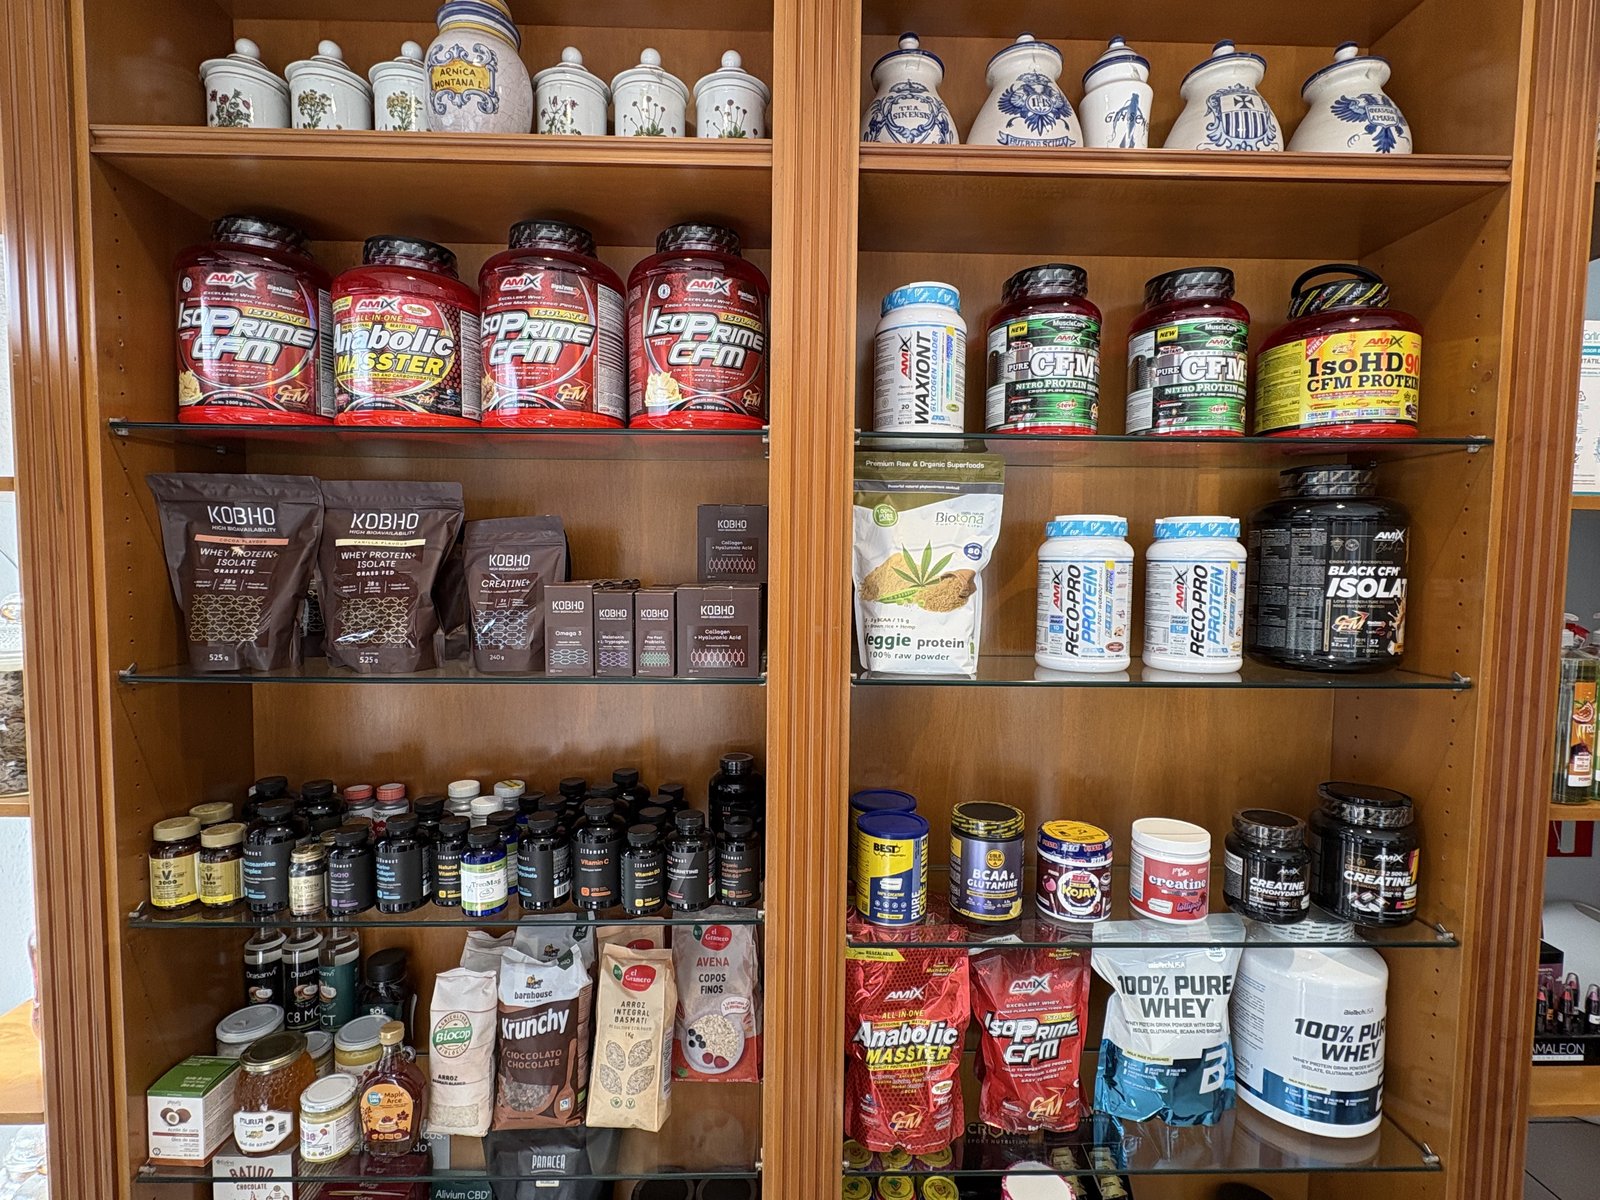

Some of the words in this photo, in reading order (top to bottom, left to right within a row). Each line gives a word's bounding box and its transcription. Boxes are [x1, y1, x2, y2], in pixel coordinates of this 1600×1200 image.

[439, 68, 477, 77] ARNICA
[434, 77, 474, 90] MONTANA
[209, 272, 255, 289] AMIX
[502, 273, 543, 291] AMIX
[689, 277, 732, 294] AMIX
[357, 298, 399, 312] AMIX
[248, 308, 307, 325] ISOLATE
[535, 309, 588, 321] ISOLATE
[1010, 325, 1026, 333] NEW
[1159, 330, 1175, 338] NEW
[334, 324, 453, 355] Anabolic
[192, 336, 281, 364] CFM
[490, 341, 563, 364] CFM
[668, 342, 746, 368] CFM
[337, 353, 444, 375] MASSTER
[1009, 362, 1029, 372] PURE
[1030, 352, 1095, 378] CFM
[1156, 367, 1180, 376] PURE
[1181, 356, 1245, 381] CFM
[915, 331, 931, 424] WAXIONT
[1307, 376, 1352, 392] CFM
[1016, 382, 1043, 390] NITRO
[1044, 379, 1087, 389] PROTEIN
[1164, 384, 1195, 395] NITRO
[1196, 383, 1237, 393] PROTEIN
[919, 461, 945, 469] Organic
[947, 461, 985, 469] Superfoods
[207, 505, 276, 525] KOBHO
[350, 513, 419, 530] KOBHO
[936, 512, 984, 524] Biotona
[718, 520, 747, 529] KOBHO
[200, 548, 230, 557] WHEY
[341, 552, 367, 560] WHEY
[217, 559, 257, 567] ISOLATE
[357, 561, 397, 569] ISOLATE
[489, 554, 531, 566] KOBHO
[1328, 566, 1376, 576] BLACK
[552, 601, 584, 610] KOBHO
[700, 605, 734, 616] KOBHO
[1066, 564, 1081, 657] RECO-PRO
[1082, 566, 1098, 644] PROTEIN
[1190, 564, 1208, 657] RECO-PRO
[1207, 566, 1224, 644] PROTEIN
[599, 609, 627, 618] KOBHO
[640, 609, 669, 618] KOBHO
[917, 637, 964, 649] protein
[915, 651, 950, 661] powder
[873, 843, 897, 853] BEST
[581, 858, 603, 866] Vitamin
[635, 870, 654, 878] Vitamin
[972, 869, 1008, 880] BCAA
[1344, 871, 1411, 886] CREATINE
[967, 880, 1018, 890] GLUTAMINE
[1149, 876, 1207, 889] creatine
[1250, 877, 1304, 890] CREATINE
[1063, 884, 1097, 899] KOJAK
[911, 891, 920, 920] PURE
[697, 957, 729, 967] AVENA
[625, 975, 652, 983] Granero
[699, 974, 726, 982] COPOS
[1012, 976, 1048, 992] AMIX
[701, 985, 723, 994] FINOS
[1118, 976, 1168, 995] 100%
[1175, 975, 1232, 995] PURE
[514, 990, 553, 999] barnhouse
[885, 987, 923, 1000] AMIX
[1140, 998, 1211, 1018] WHEY
[881, 1010, 924, 1020] ALL-IN-ONE
[502, 1008, 570, 1040] Krunchy
[435, 1027, 471, 1044] Biocop
[854, 1022, 958, 1047] Anabolic
[1294, 1018, 1354, 1044] 100%
[1359, 1019, 1386, 1043] PUR
[506, 1049, 562, 1059] CIOCCOLATO
[866, 1046, 951, 1064] MASSTER
[1005, 1039, 1059, 1063] CFM
[1321, 1042, 1379, 1062] WHEY
[507, 1059, 560, 1069] CHOCOLATE
[1293, 1056, 1308, 1064] WHEY
[1309, 1061, 1332, 1069] PROTEIN
[385, 1091, 404, 1099] Maple
[532, 1154, 566, 1169] PANACEA
[436, 1190, 465, 1199] Alivium
